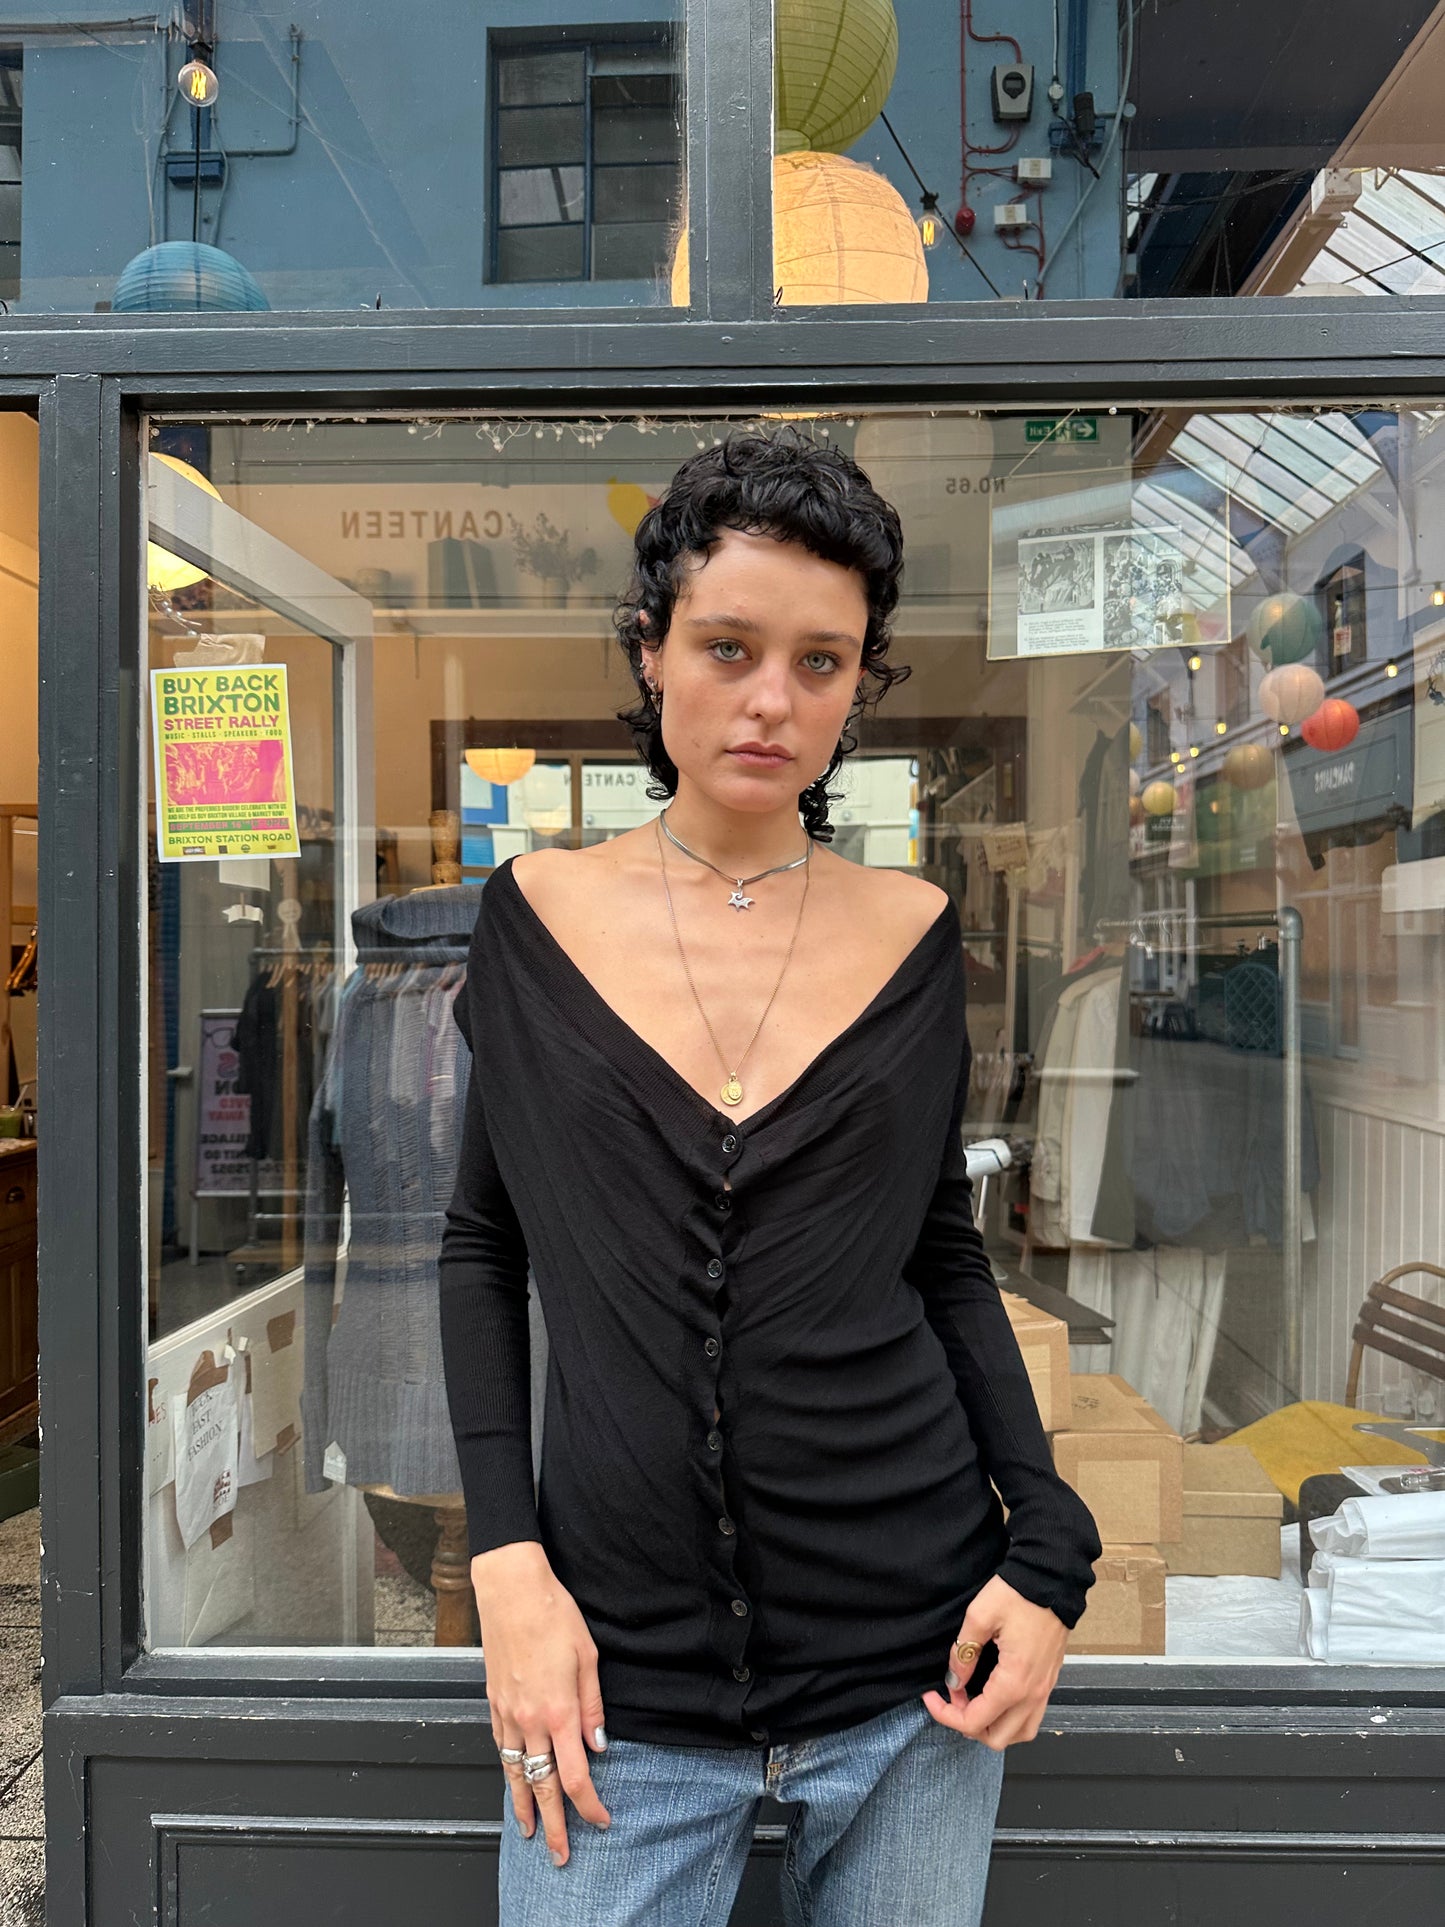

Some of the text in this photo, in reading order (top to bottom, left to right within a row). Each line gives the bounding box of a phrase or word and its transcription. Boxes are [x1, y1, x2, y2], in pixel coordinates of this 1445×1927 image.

[163, 674, 279, 695] BUY BACK
[164, 692, 281, 716] BRIXTON
[164, 715, 280, 731] STREET RALLY
[164, 732, 185, 740] MUSIC
[192, 731, 217, 739] STALLS
[223, 730, 258, 738] SPEAKERS
[169, 821, 228, 831] SEPTEMBER
[168, 832, 292, 845] BRIXTON STATION ROAD
[192, 1408, 212, 1436] FAST
[188, 1418, 225, 1462] FASHION
